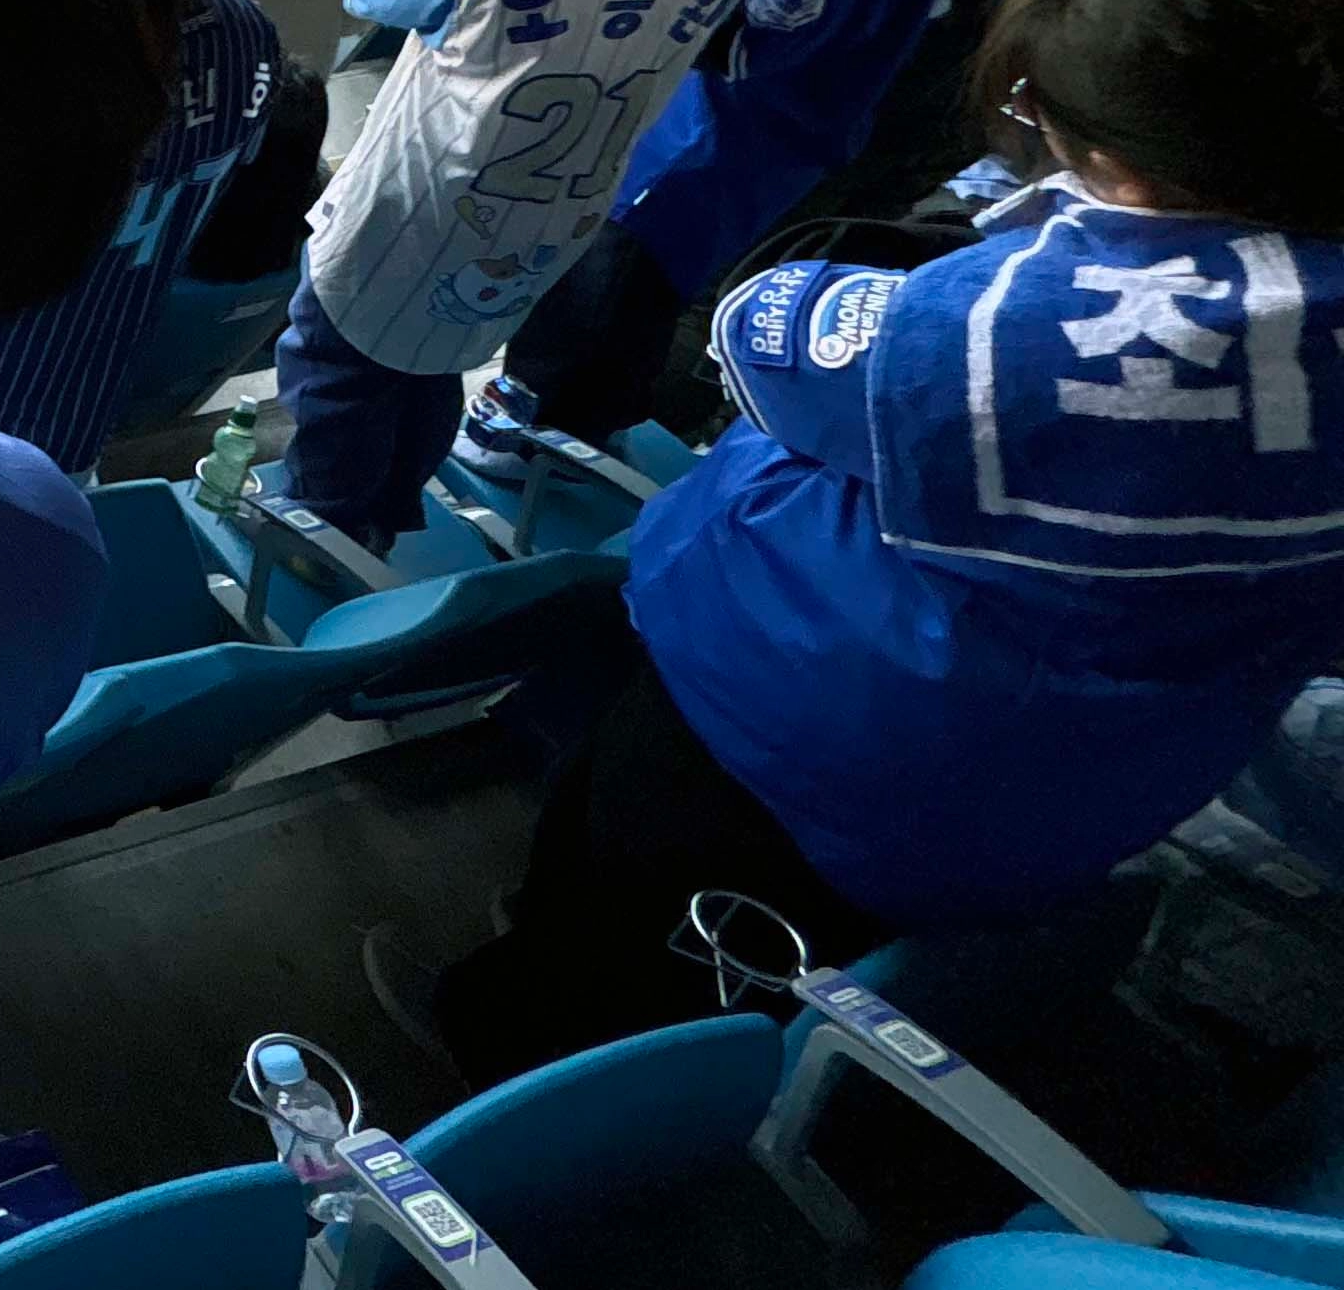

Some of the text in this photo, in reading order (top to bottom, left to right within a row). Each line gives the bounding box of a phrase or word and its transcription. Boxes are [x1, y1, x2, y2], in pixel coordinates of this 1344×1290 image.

[470, 68, 662, 205] 21
[111, 143, 242, 269] 47
[1055, 231, 1315, 454] 최
